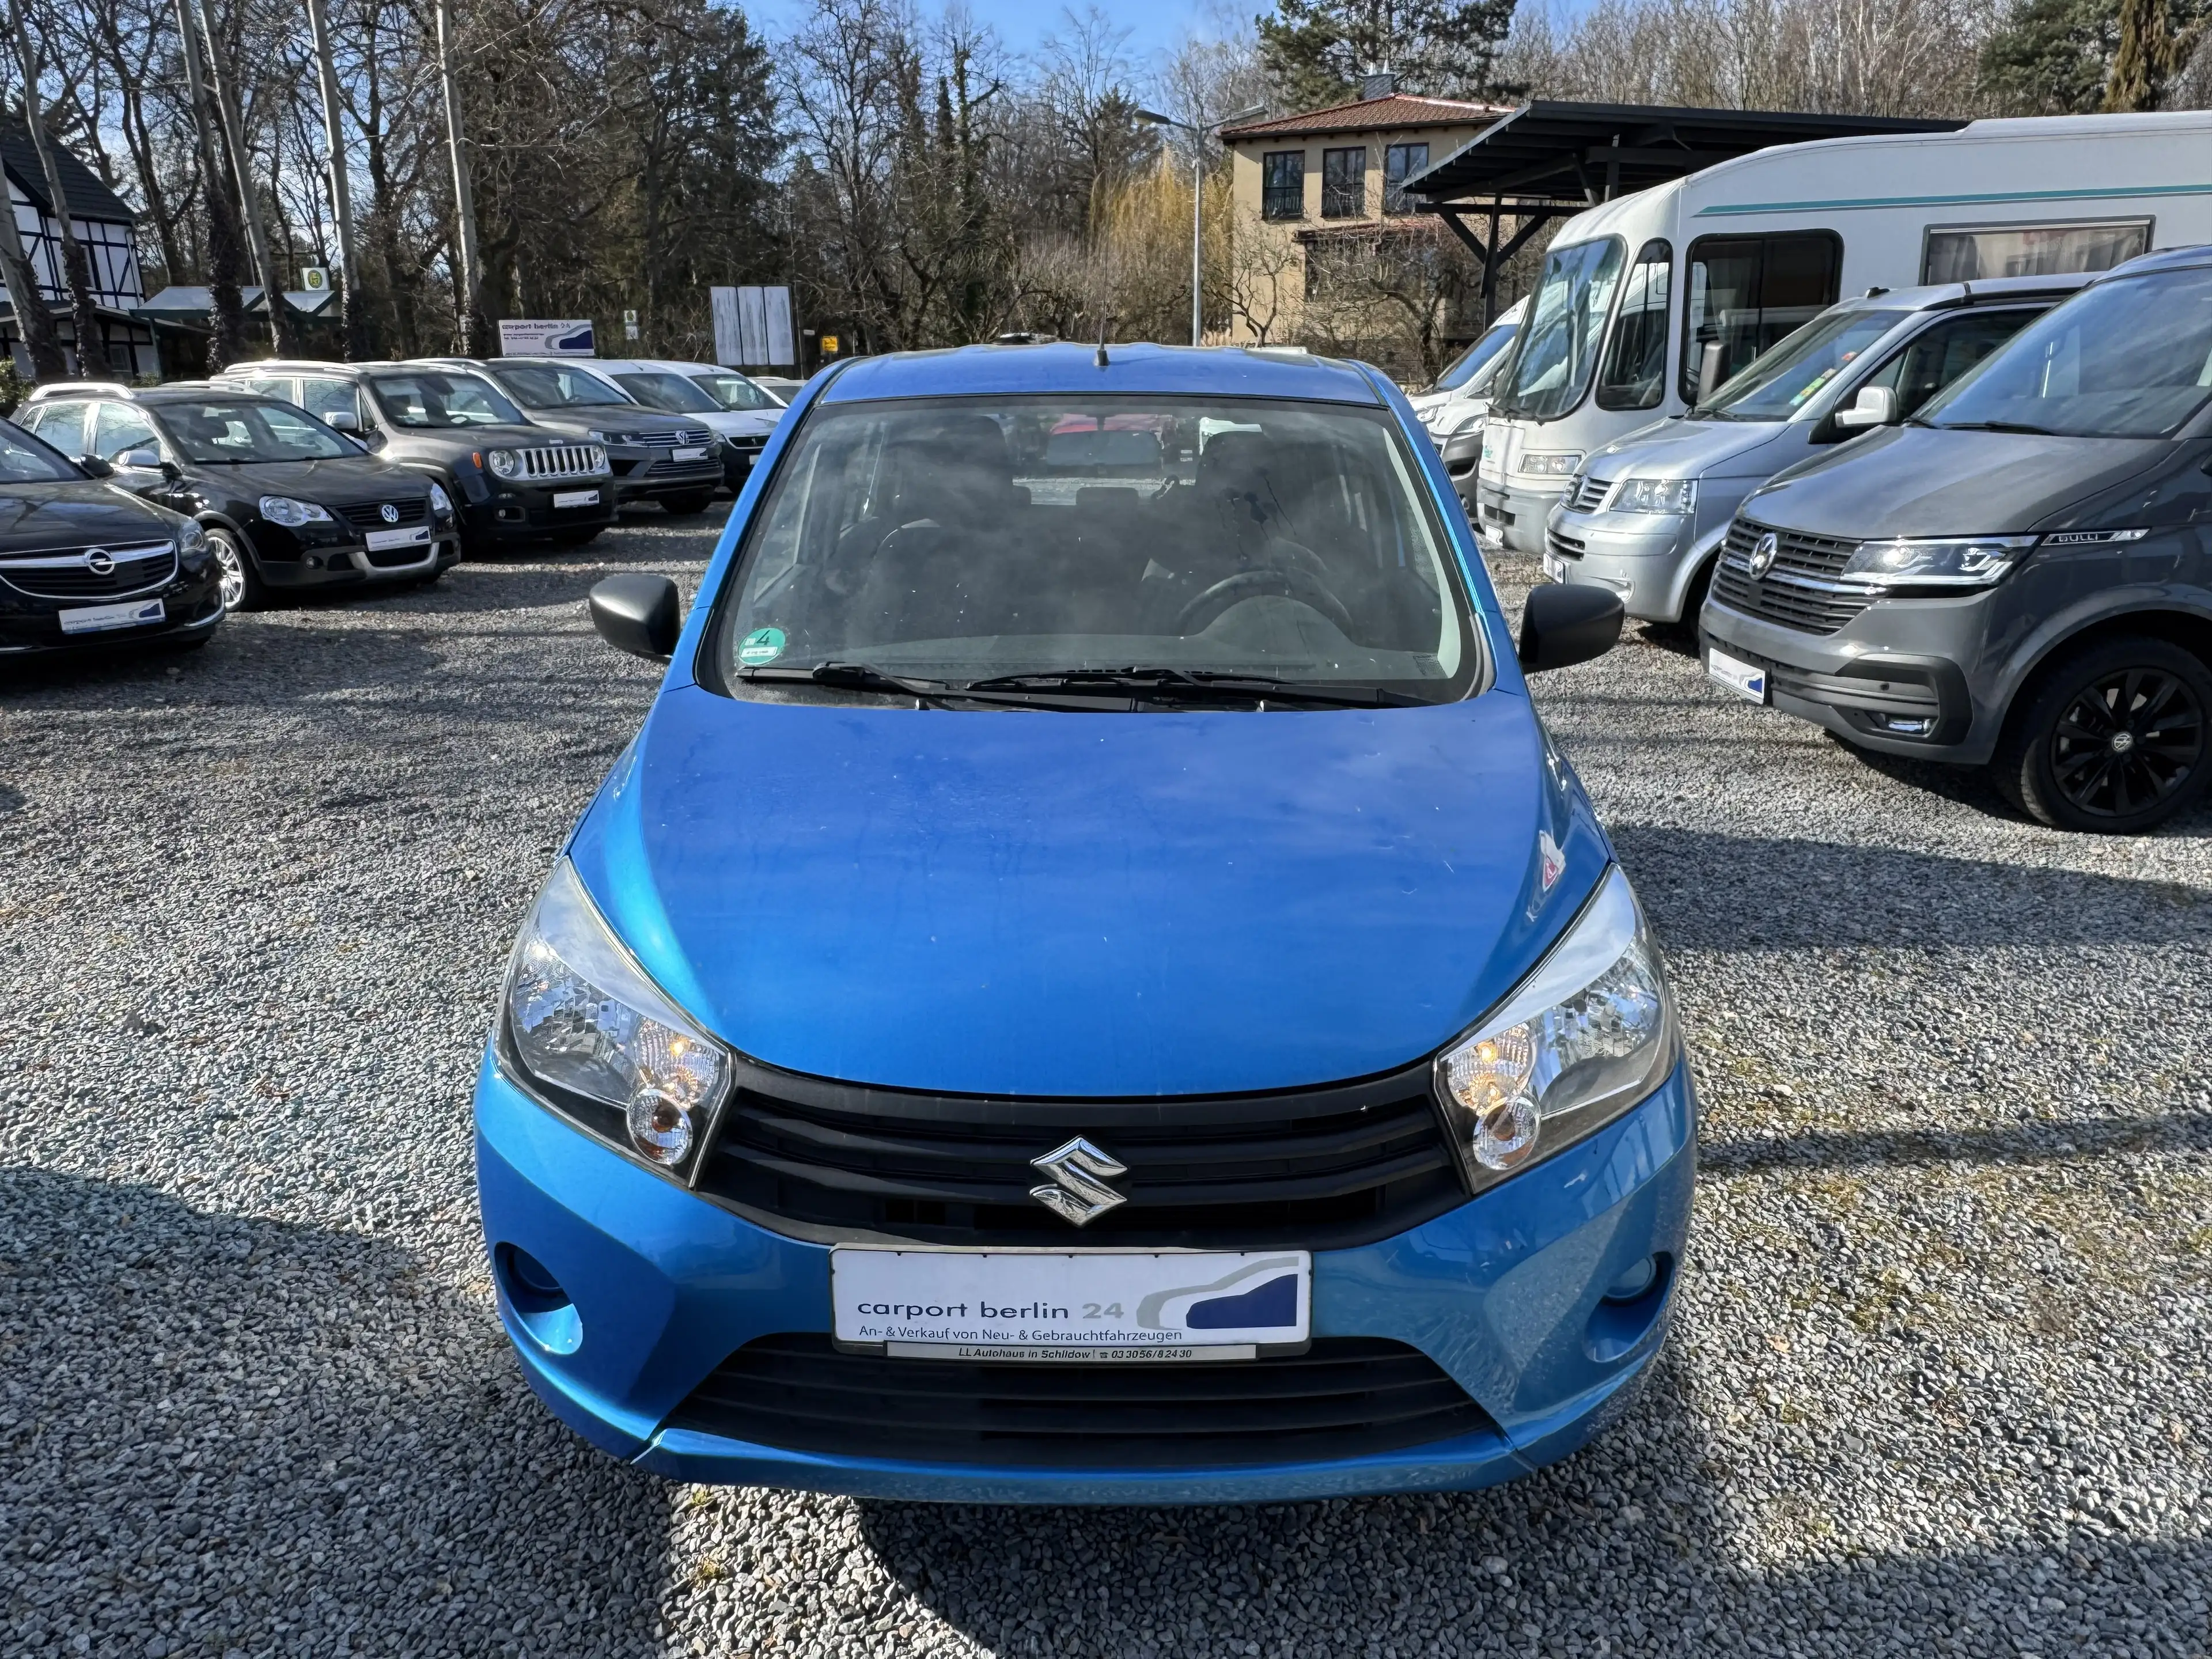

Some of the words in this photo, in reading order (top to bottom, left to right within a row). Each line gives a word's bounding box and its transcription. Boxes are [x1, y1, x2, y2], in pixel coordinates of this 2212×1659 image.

[756, 630, 770, 646] 4
[857, 1303, 968, 1320] carport
[980, 1301, 1069, 1319] berlin
[1081, 1302, 1124, 1319] 24
[859, 1325, 883, 1336] An-
[886, 1326, 896, 1337] &
[898, 1327, 950, 1339] Verkauf
[953, 1331, 978, 1339] von
[983, 1329, 1015, 1340] Neu-
[1018, 1330, 1028, 1340] &
[1032, 1329, 1183, 1343] Gebrauchtfahrzeugen
[958, 1347, 974, 1357] LL
[974, 1349, 1025, 1358] Autohaus
[1028, 1349, 1037, 1358] in
[1041, 1350, 1091, 1359] Schildow
